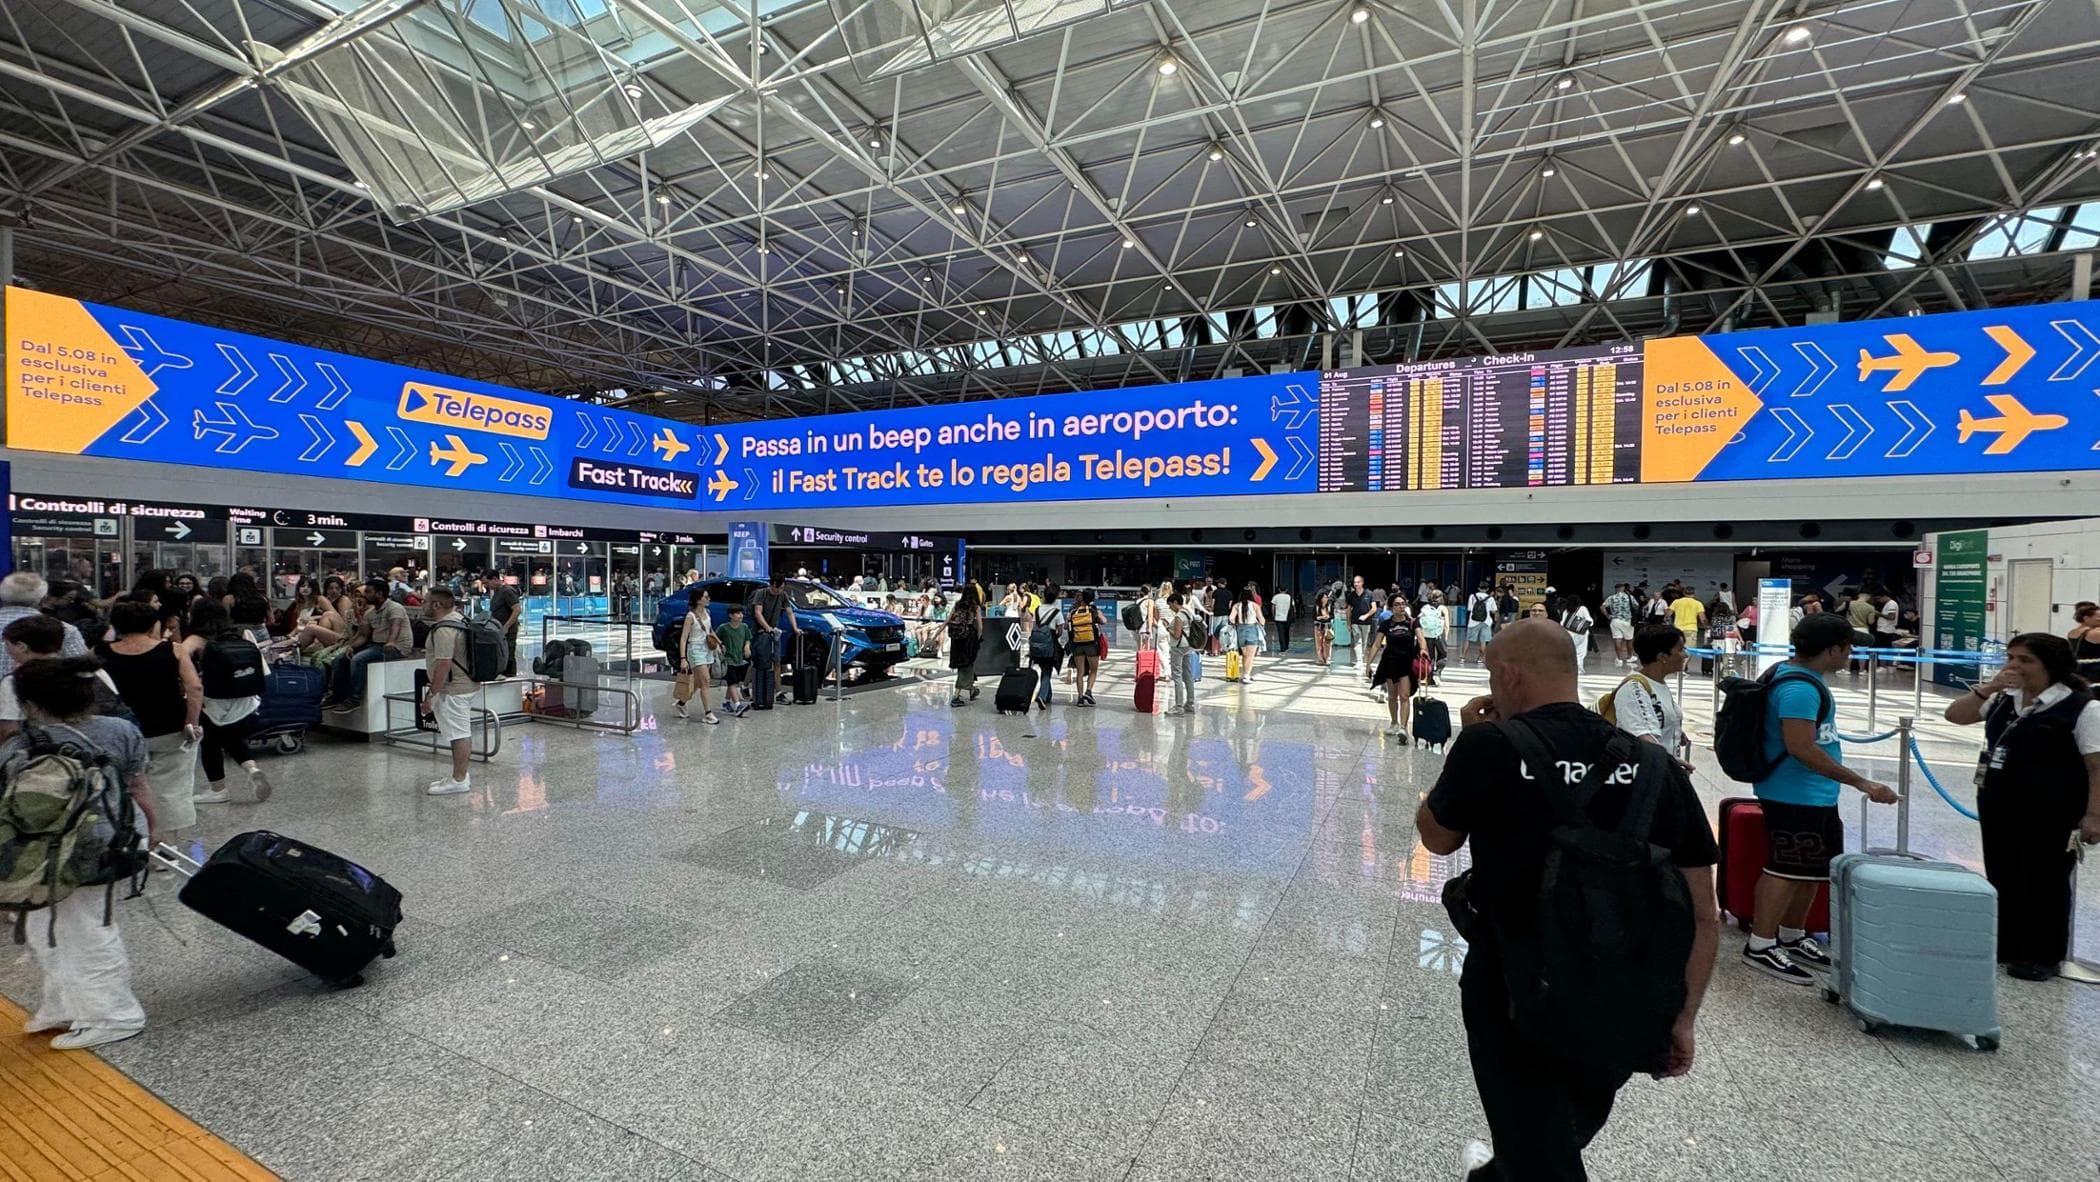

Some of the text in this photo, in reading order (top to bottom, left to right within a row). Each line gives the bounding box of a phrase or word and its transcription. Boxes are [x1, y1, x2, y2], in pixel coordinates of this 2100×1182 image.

[21, 340, 118, 366] Dal 5.08 in
[21, 357, 107, 378] esclusiva
[1396, 361, 1456, 374] Departures
[21, 374, 127, 395] per i clienti
[1657, 380, 1731, 394] Dal 5.08 in
[23, 386, 103, 406] Telepass
[1656, 395, 1722, 407] esclusiva
[432, 392, 549, 432] Telepass
[1656, 412, 1680, 424] per
[1691, 407, 1738, 419] clienti
[742, 400, 1239, 458] Passa in un beep anche in aeroporto:
[1656, 424, 1717, 436] Telepass
[578, 462, 682, 493] Fast Track
[772, 447, 1231, 494] il Fast Track te lo regala Telepass!
[20, 497, 206, 519] Controlli di sicurezza
[229, 508, 267, 519] Waiting
[307, 514, 348, 527] 3 min.
[431, 521, 530, 535] Controlli di sicurezza
[549, 527, 584, 538] Imbarchi
[816, 531, 868, 544] Security control
[919, 538, 934, 548] Gates
